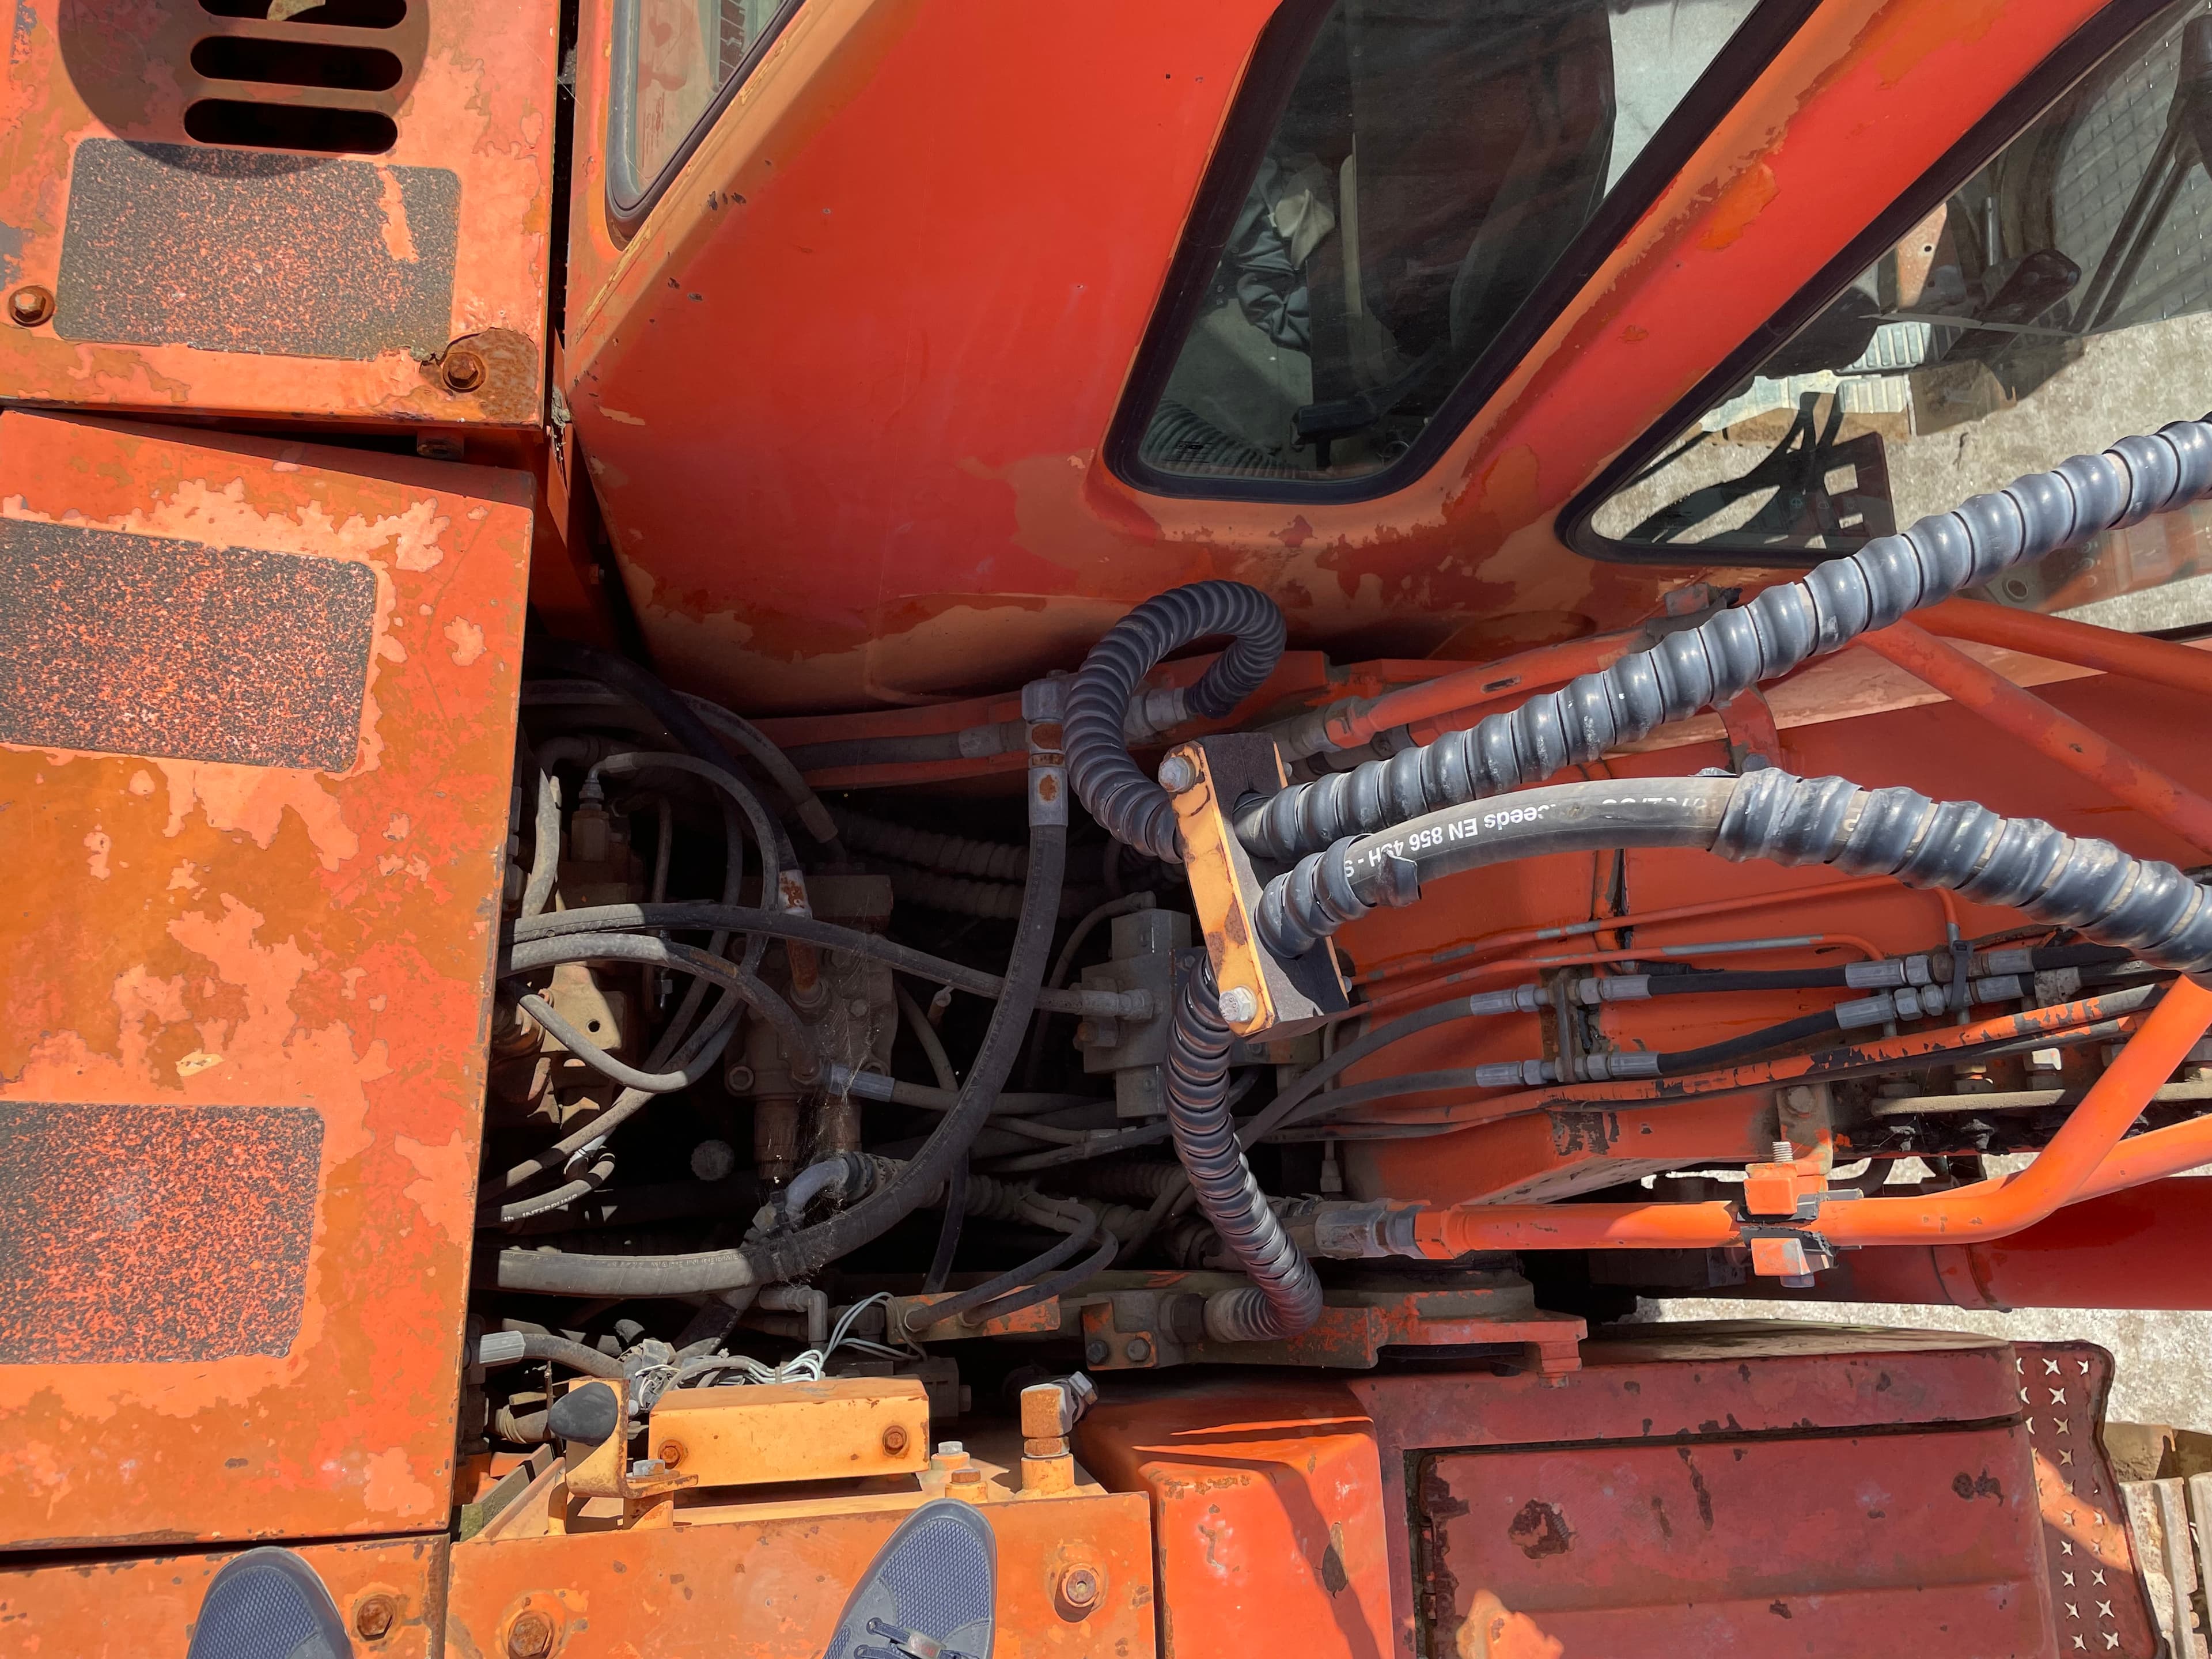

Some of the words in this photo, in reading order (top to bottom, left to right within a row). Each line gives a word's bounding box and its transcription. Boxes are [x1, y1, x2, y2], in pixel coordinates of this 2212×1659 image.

[1448, 818, 1479, 840] EN
[1484, 804, 1556, 831] ceeds
[1409, 827, 1443, 851] 856
